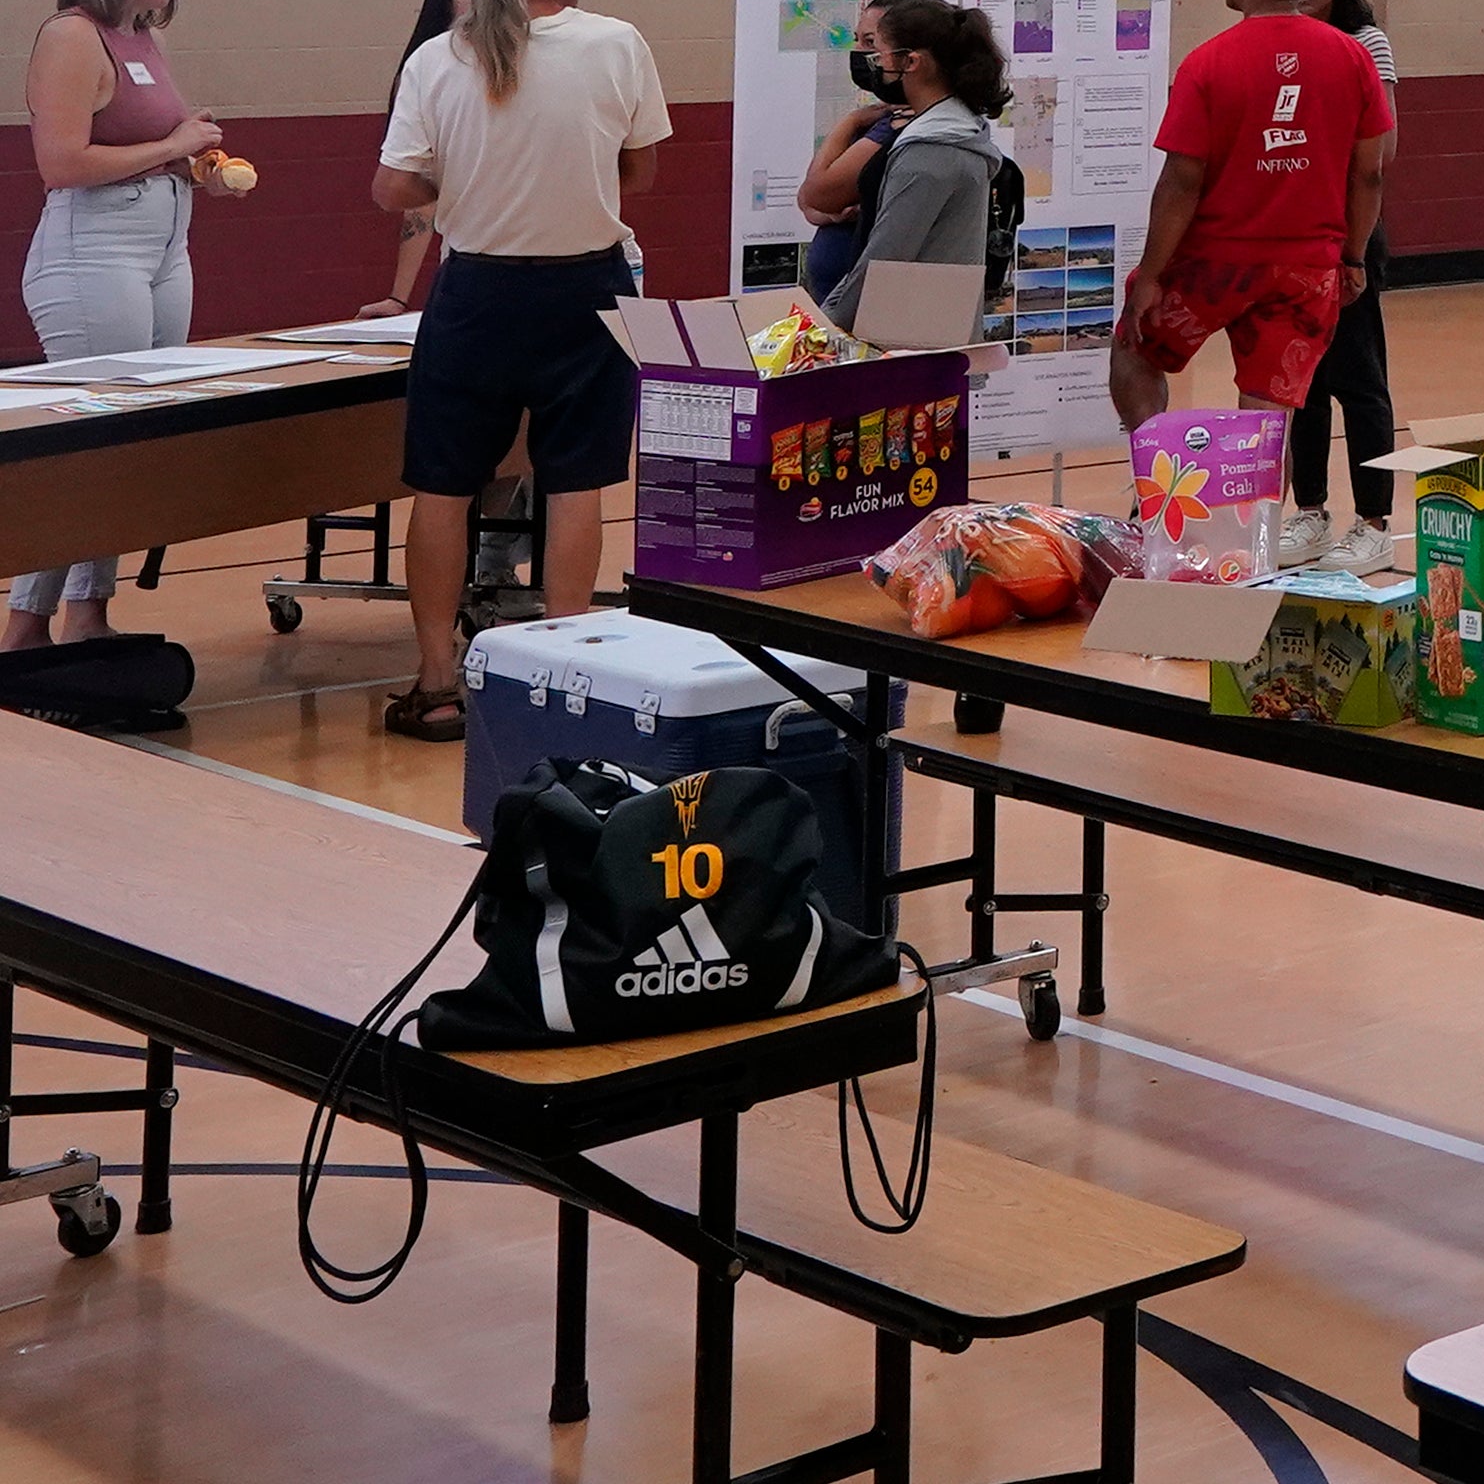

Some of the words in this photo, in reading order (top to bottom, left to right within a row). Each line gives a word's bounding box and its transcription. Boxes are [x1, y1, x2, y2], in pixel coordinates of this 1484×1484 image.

[1269, 129, 1305, 144] FLAG
[1257, 157, 1310, 174] INFERNO
[855, 482, 882, 500] FUN
[912, 475, 934, 496] 54
[1435, 477, 1468, 497] POUCHES
[830, 497, 879, 520] FLAVOR
[881, 492, 906, 509] MIX
[1421, 506, 1473, 543] CRUNCHY
[1275, 636, 1309, 647] TRAIL
[1281, 646, 1303, 656] MIX
[651, 842, 724, 900] 10
[614, 961, 750, 998] adidas
